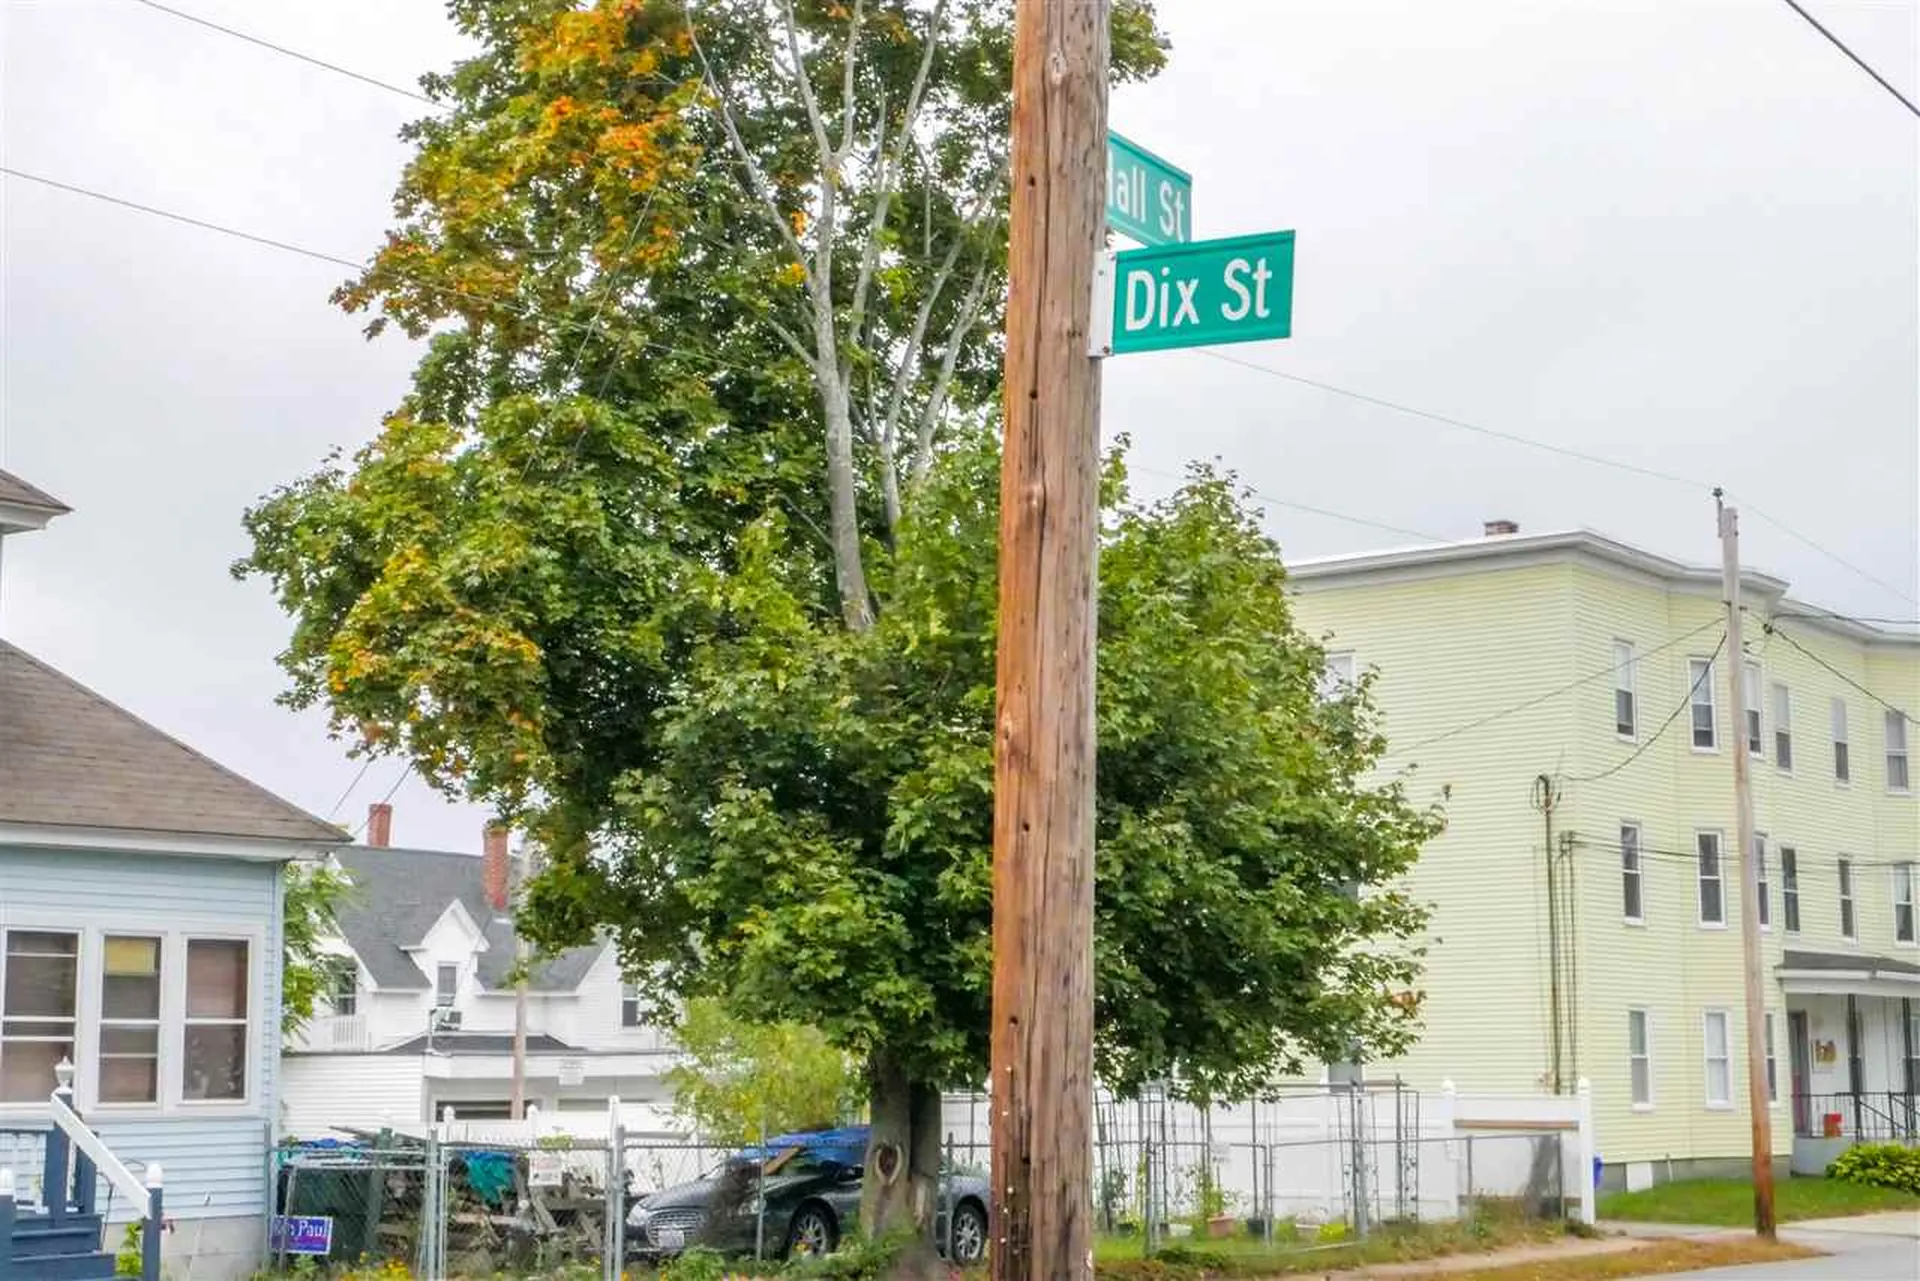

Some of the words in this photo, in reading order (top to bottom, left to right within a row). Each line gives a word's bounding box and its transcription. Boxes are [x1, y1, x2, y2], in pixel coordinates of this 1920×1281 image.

[1158, 179, 1184, 242] St
[1125, 266, 1200, 331] Dix
[1220, 257, 1273, 322] St
[297, 1219, 328, 1237] Paul
